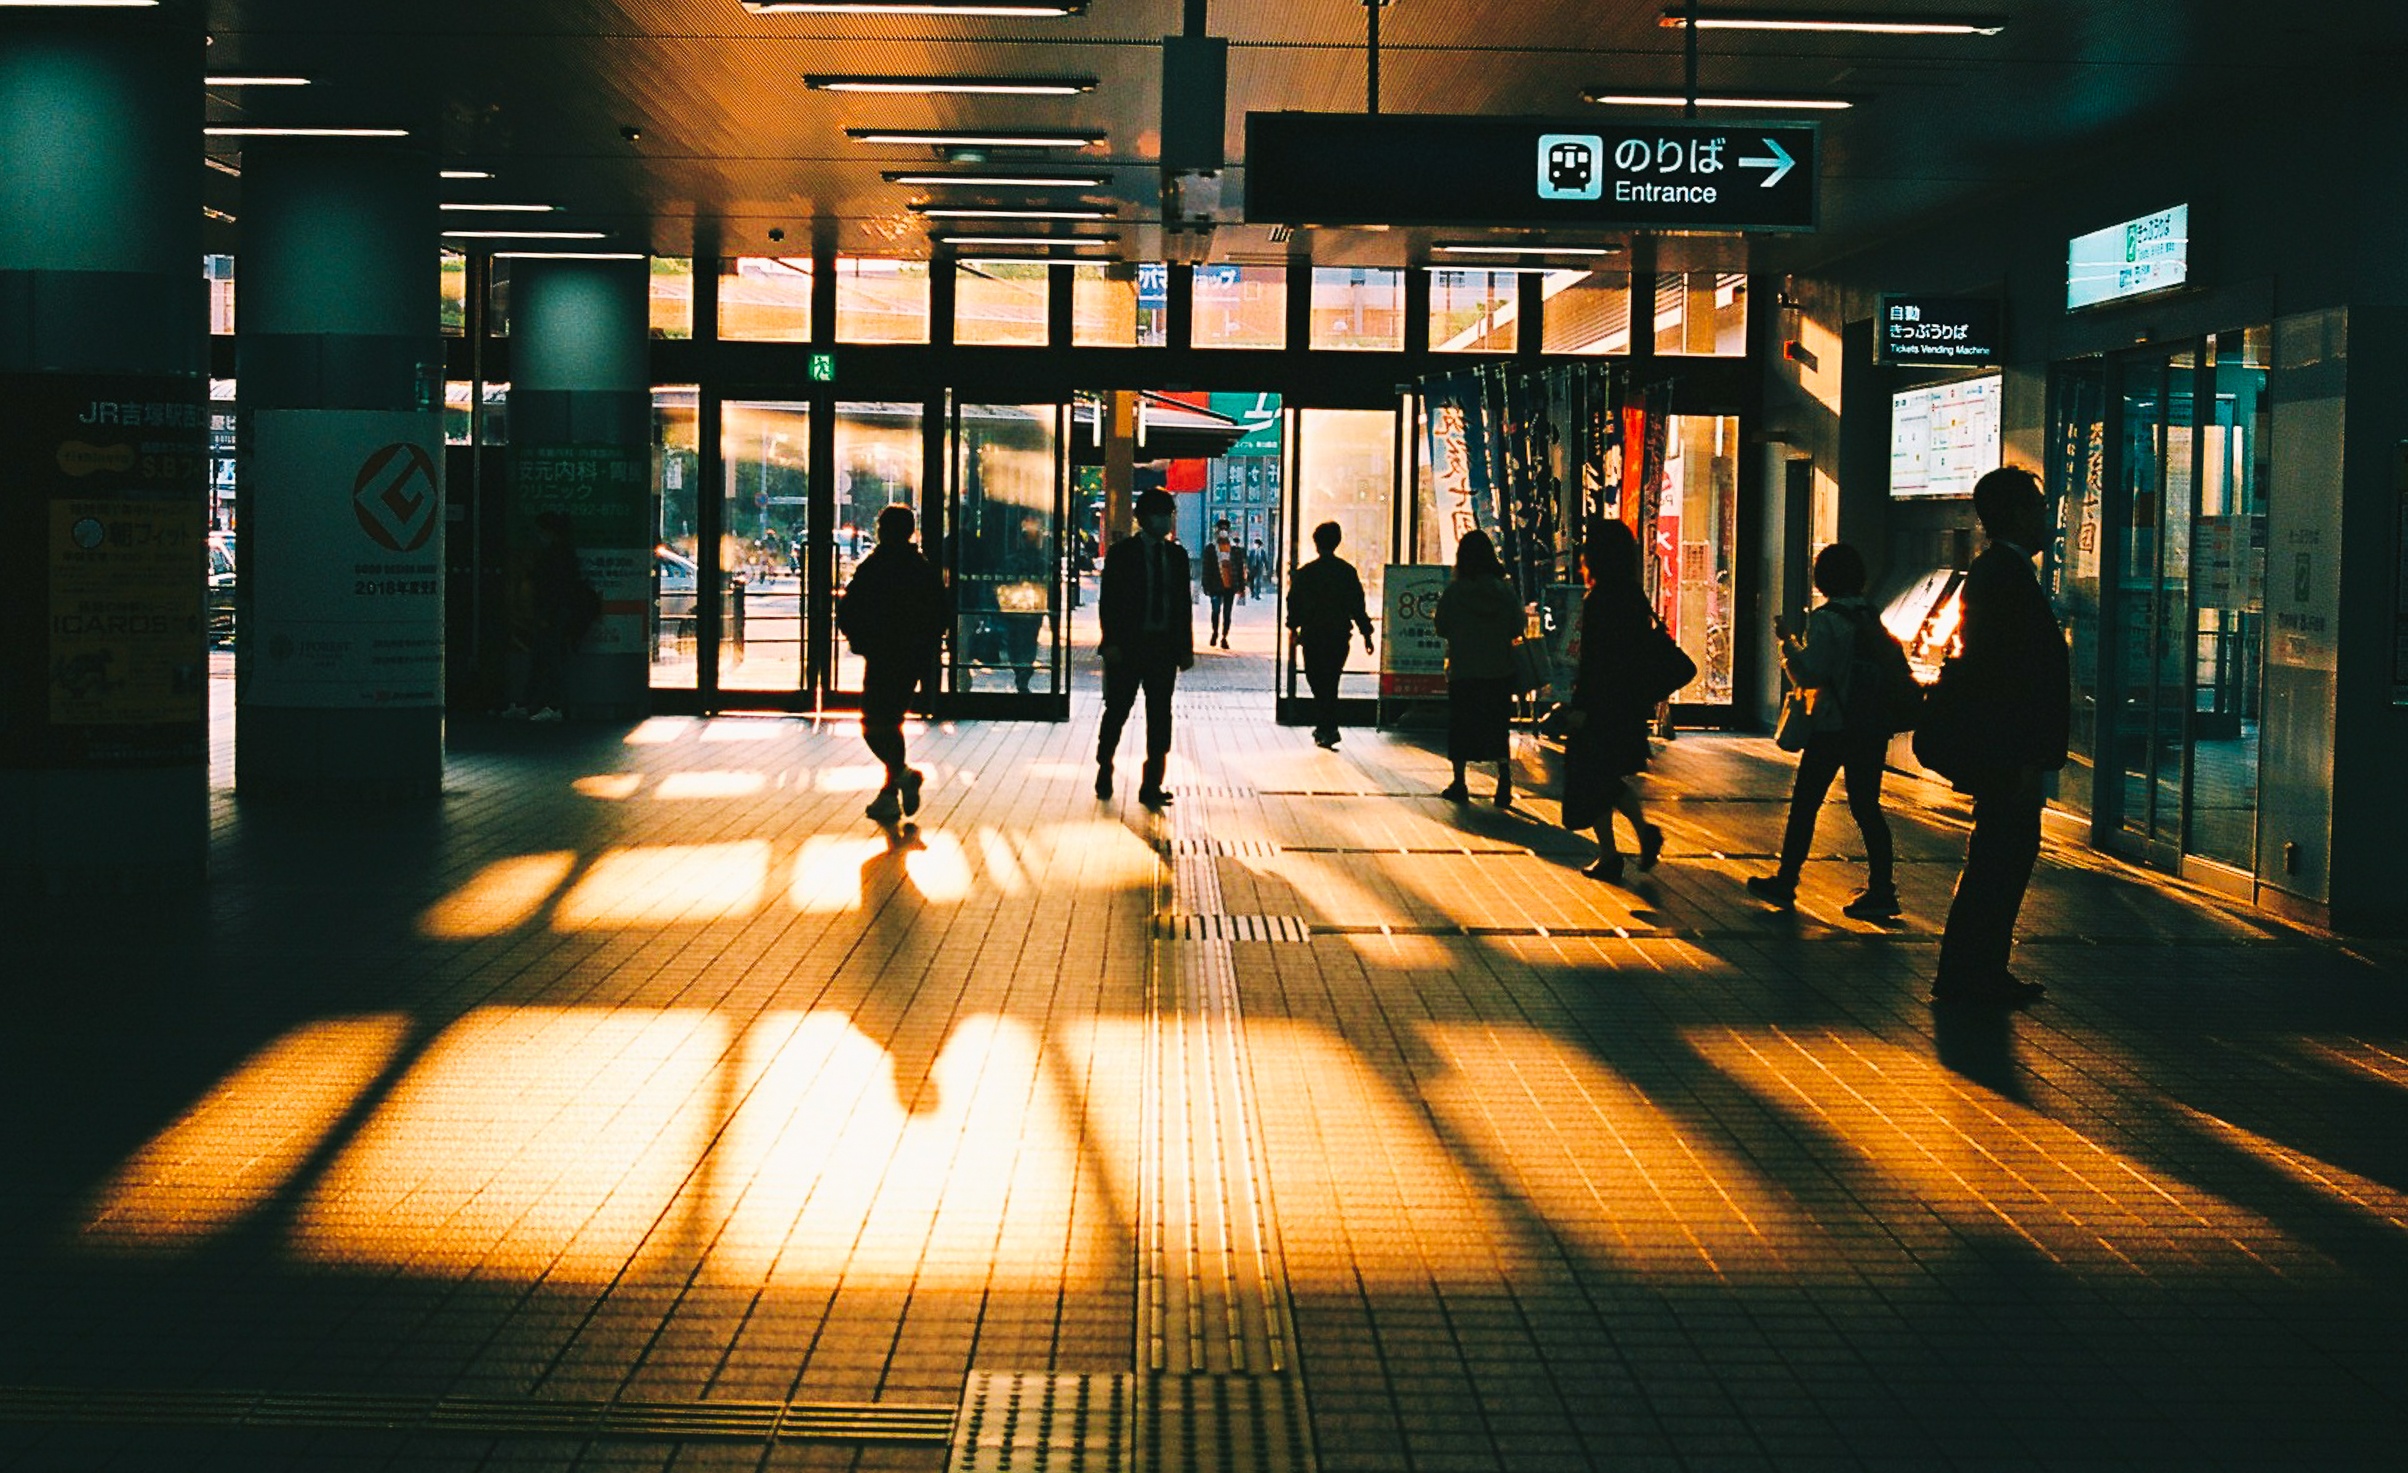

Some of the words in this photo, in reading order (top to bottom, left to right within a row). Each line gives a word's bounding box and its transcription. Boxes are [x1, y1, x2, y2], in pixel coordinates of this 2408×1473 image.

[1615, 138, 1726, 174] のりば
[1616, 181, 1717, 203] Entrance
[1889, 305, 1921, 322] 自動
[1889, 323, 1970, 341] きっぷうりば
[1890, 343, 1919, 354] Tickets
[1920, 344, 1954, 356] Vending
[1956, 345, 1990, 356] Machine
[518, 483, 593, 501] クリニック
